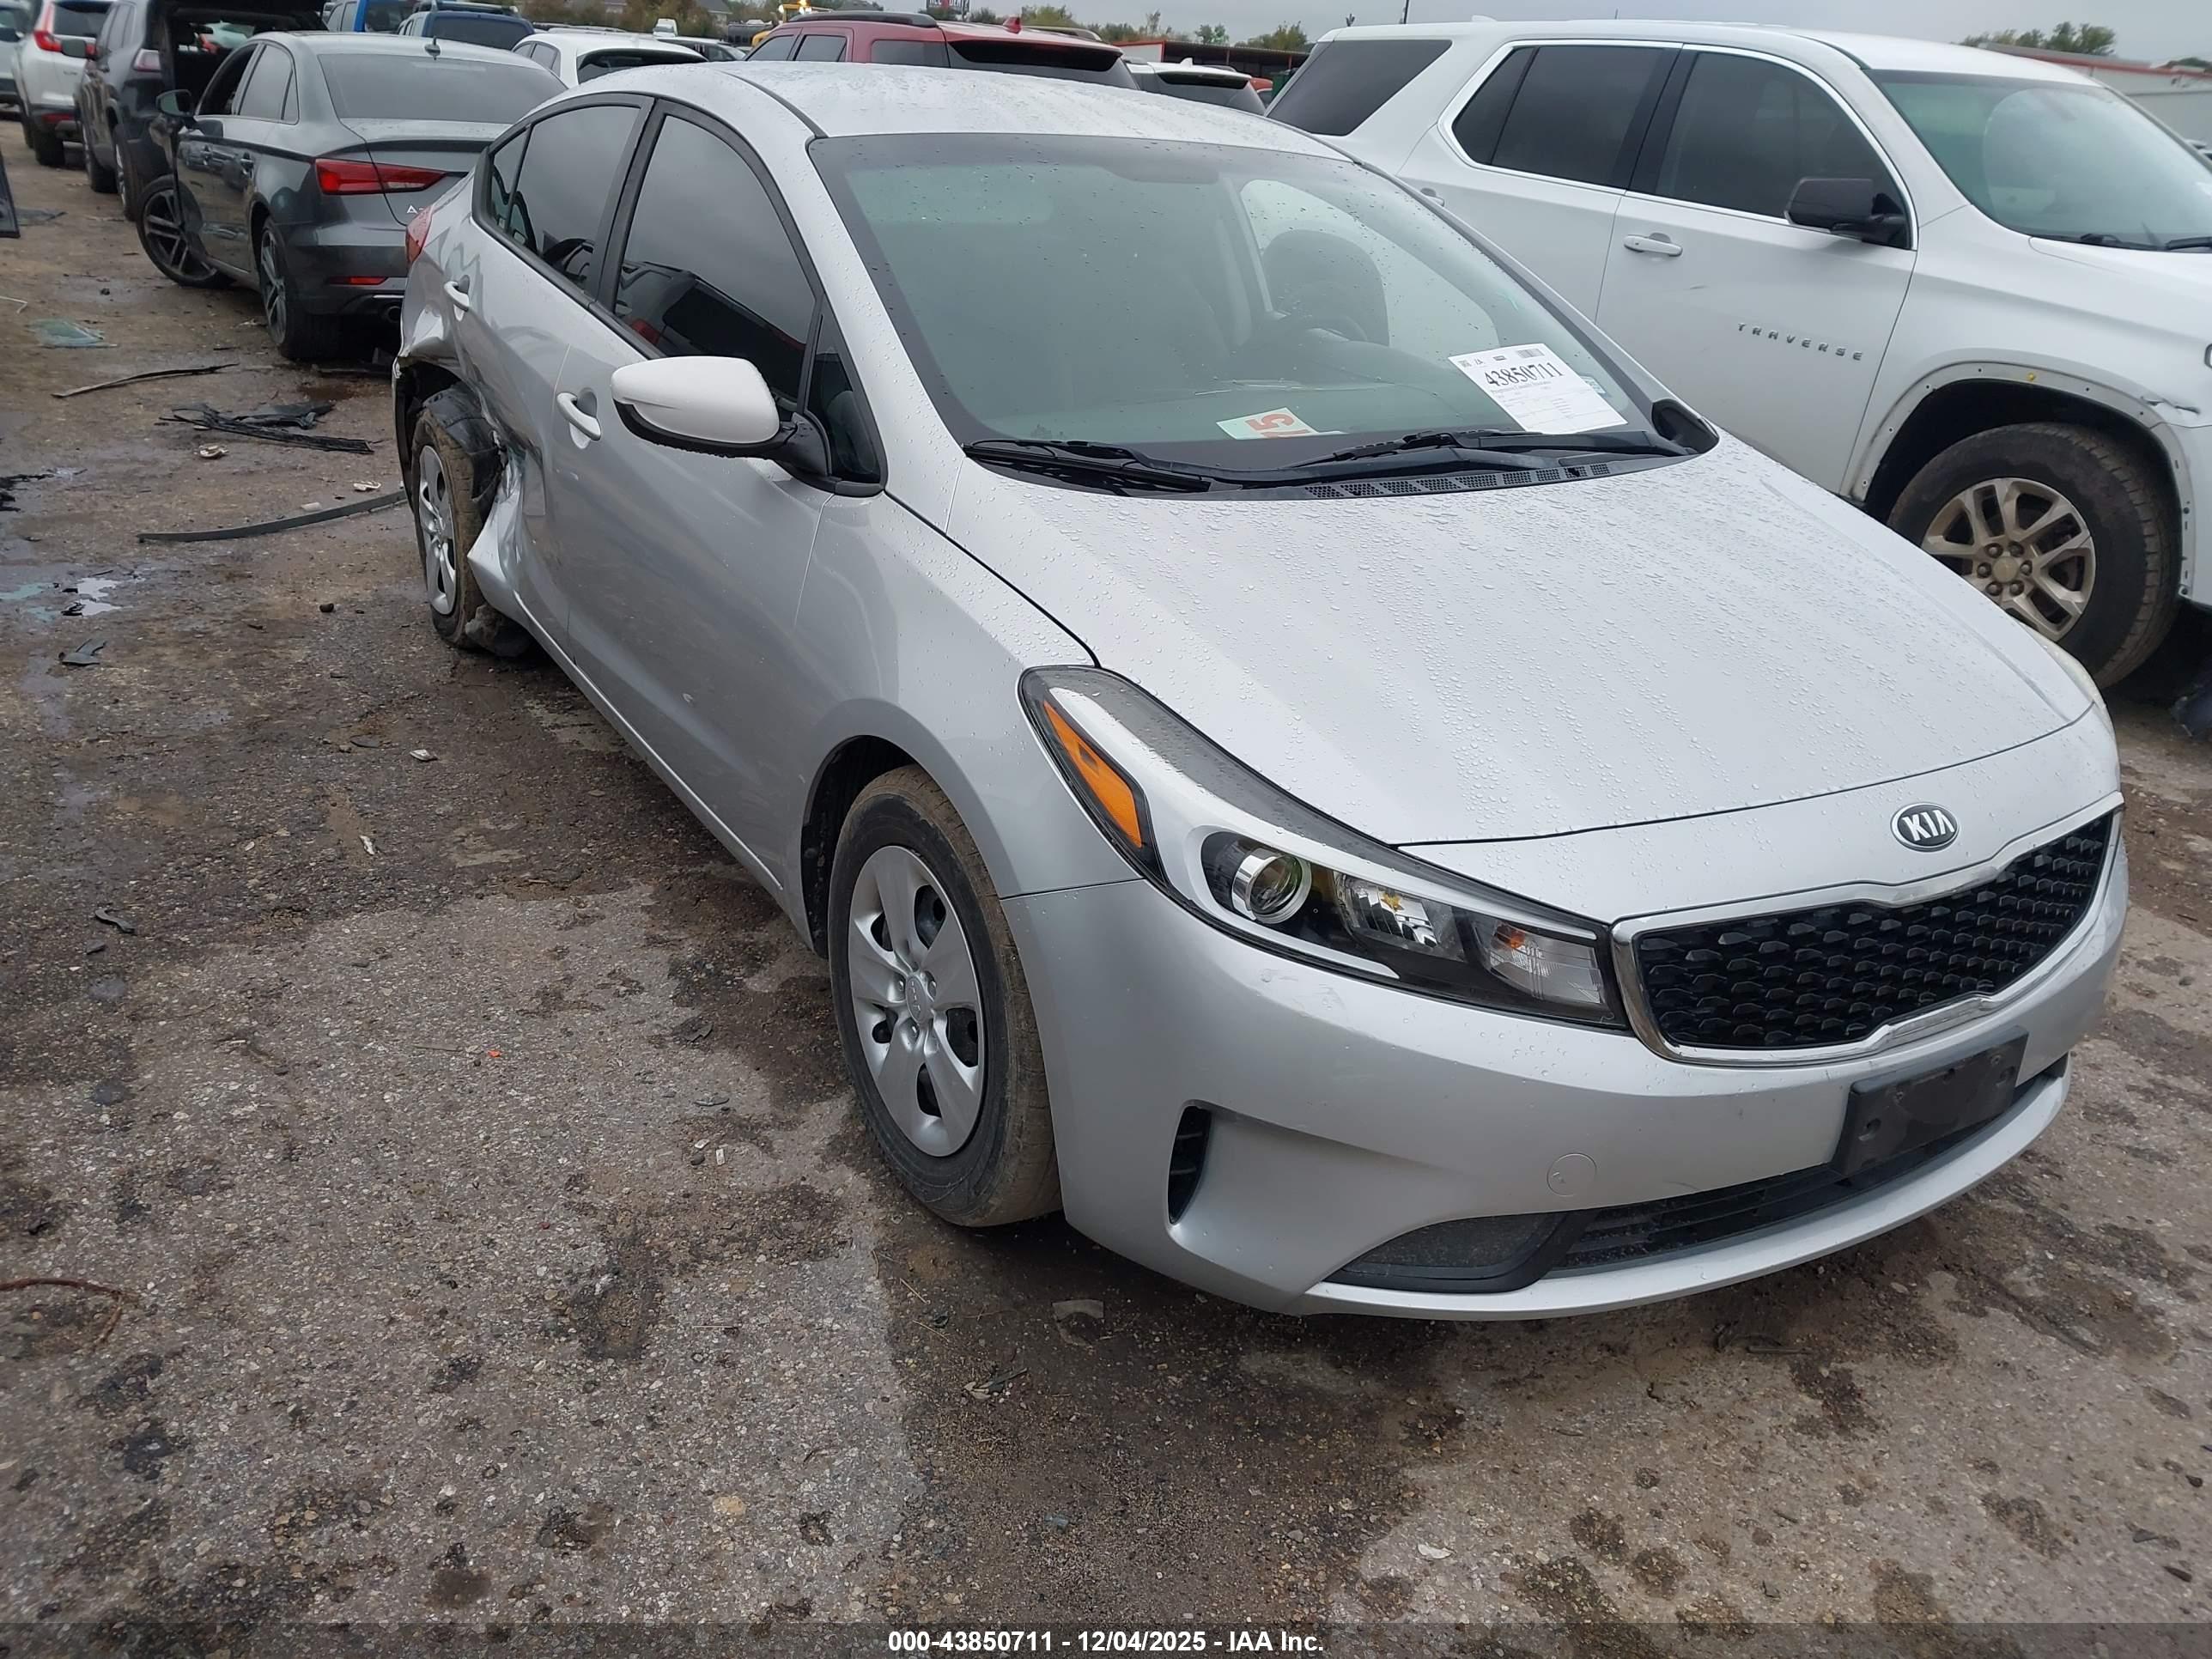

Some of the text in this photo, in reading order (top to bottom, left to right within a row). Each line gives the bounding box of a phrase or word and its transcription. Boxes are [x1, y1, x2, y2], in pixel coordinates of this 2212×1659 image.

[1738, 322, 1863, 361] TRAVERSE
[1484, 362, 1563, 386] 43850711
[1901, 809, 1955, 842] KIA
